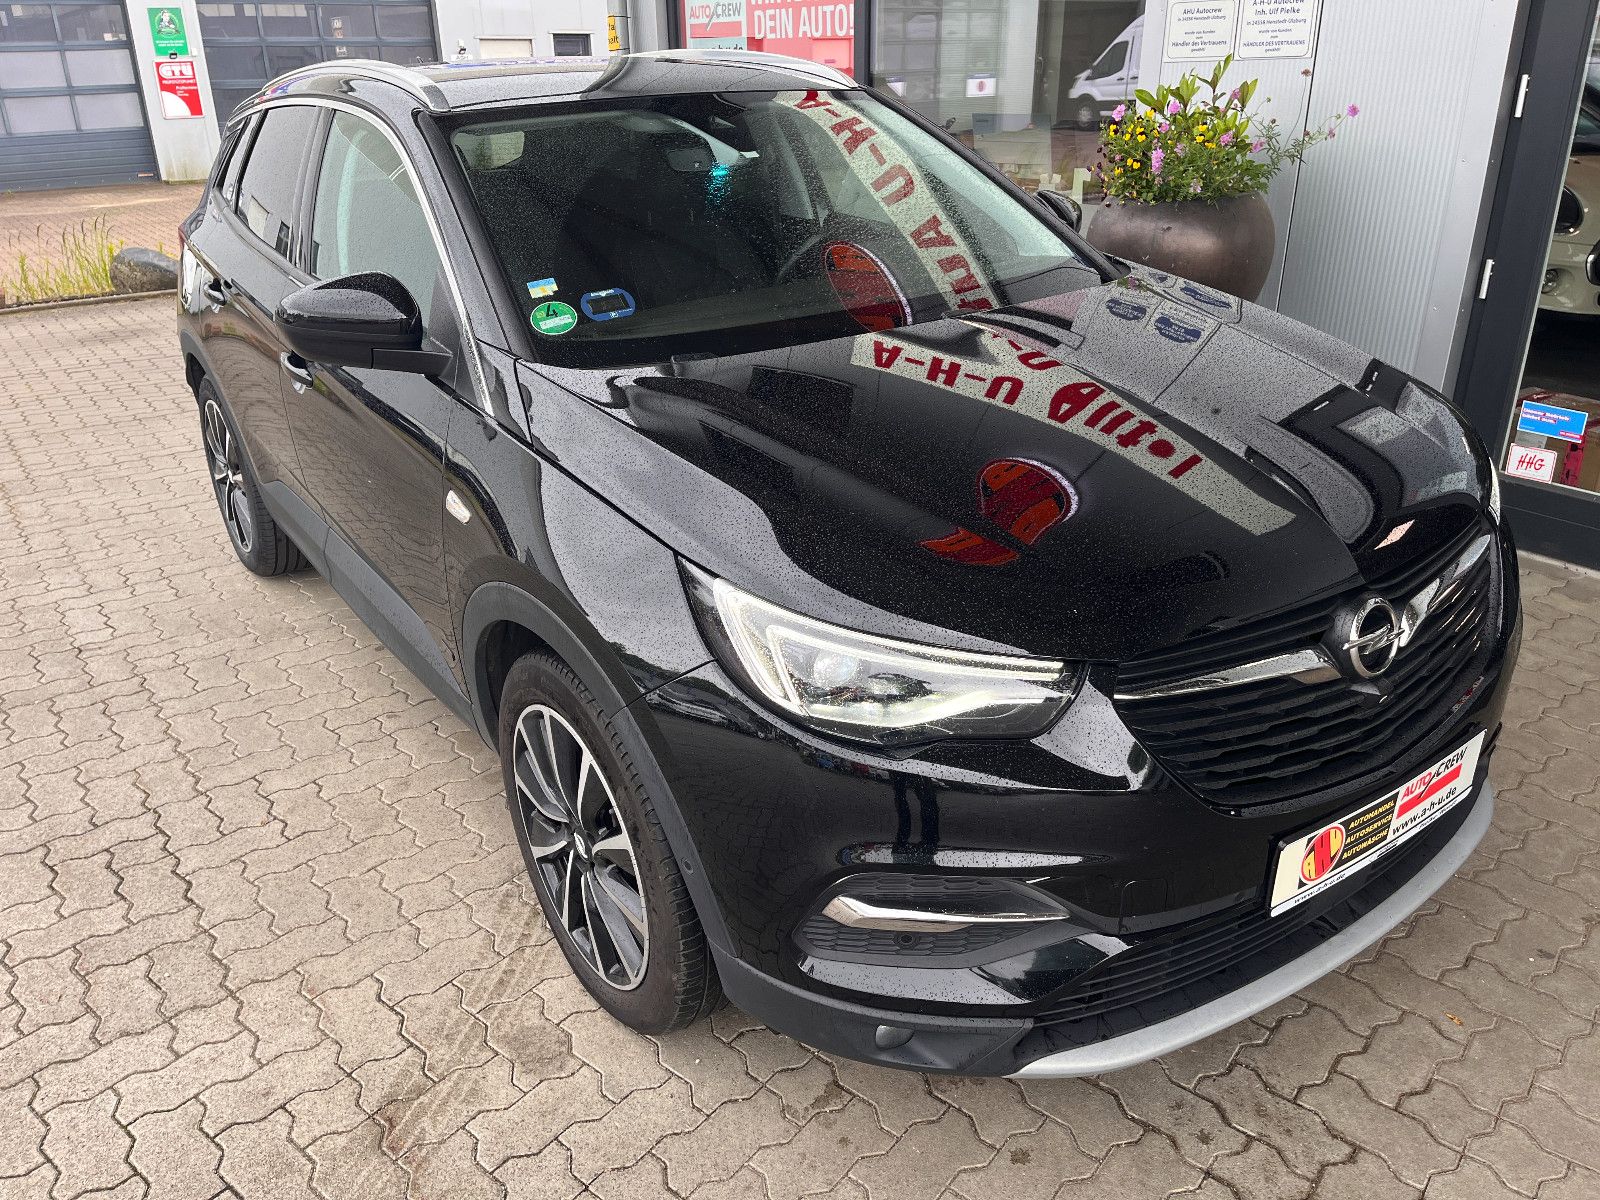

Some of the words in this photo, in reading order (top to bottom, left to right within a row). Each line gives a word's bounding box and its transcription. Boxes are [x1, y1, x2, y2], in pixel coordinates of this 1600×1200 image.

[689, 5, 712, 20] AUTO
[714, 2, 741, 18] CREW
[753, 7, 792, 40] DEIN
[798, 4, 854, 39] AUTO!
[545, 303, 559, 318] 4
[1515, 453, 1545, 471] HHG
[1402, 771, 1434, 801] AUTO
[1434, 745, 1468, 779] CREW
[1349, 800, 1395, 829] AUTOHANDEL
[1391, 786, 1457, 836] www.a-h-u.de
[1345, 814, 1393, 845] AUTOSERVICE
